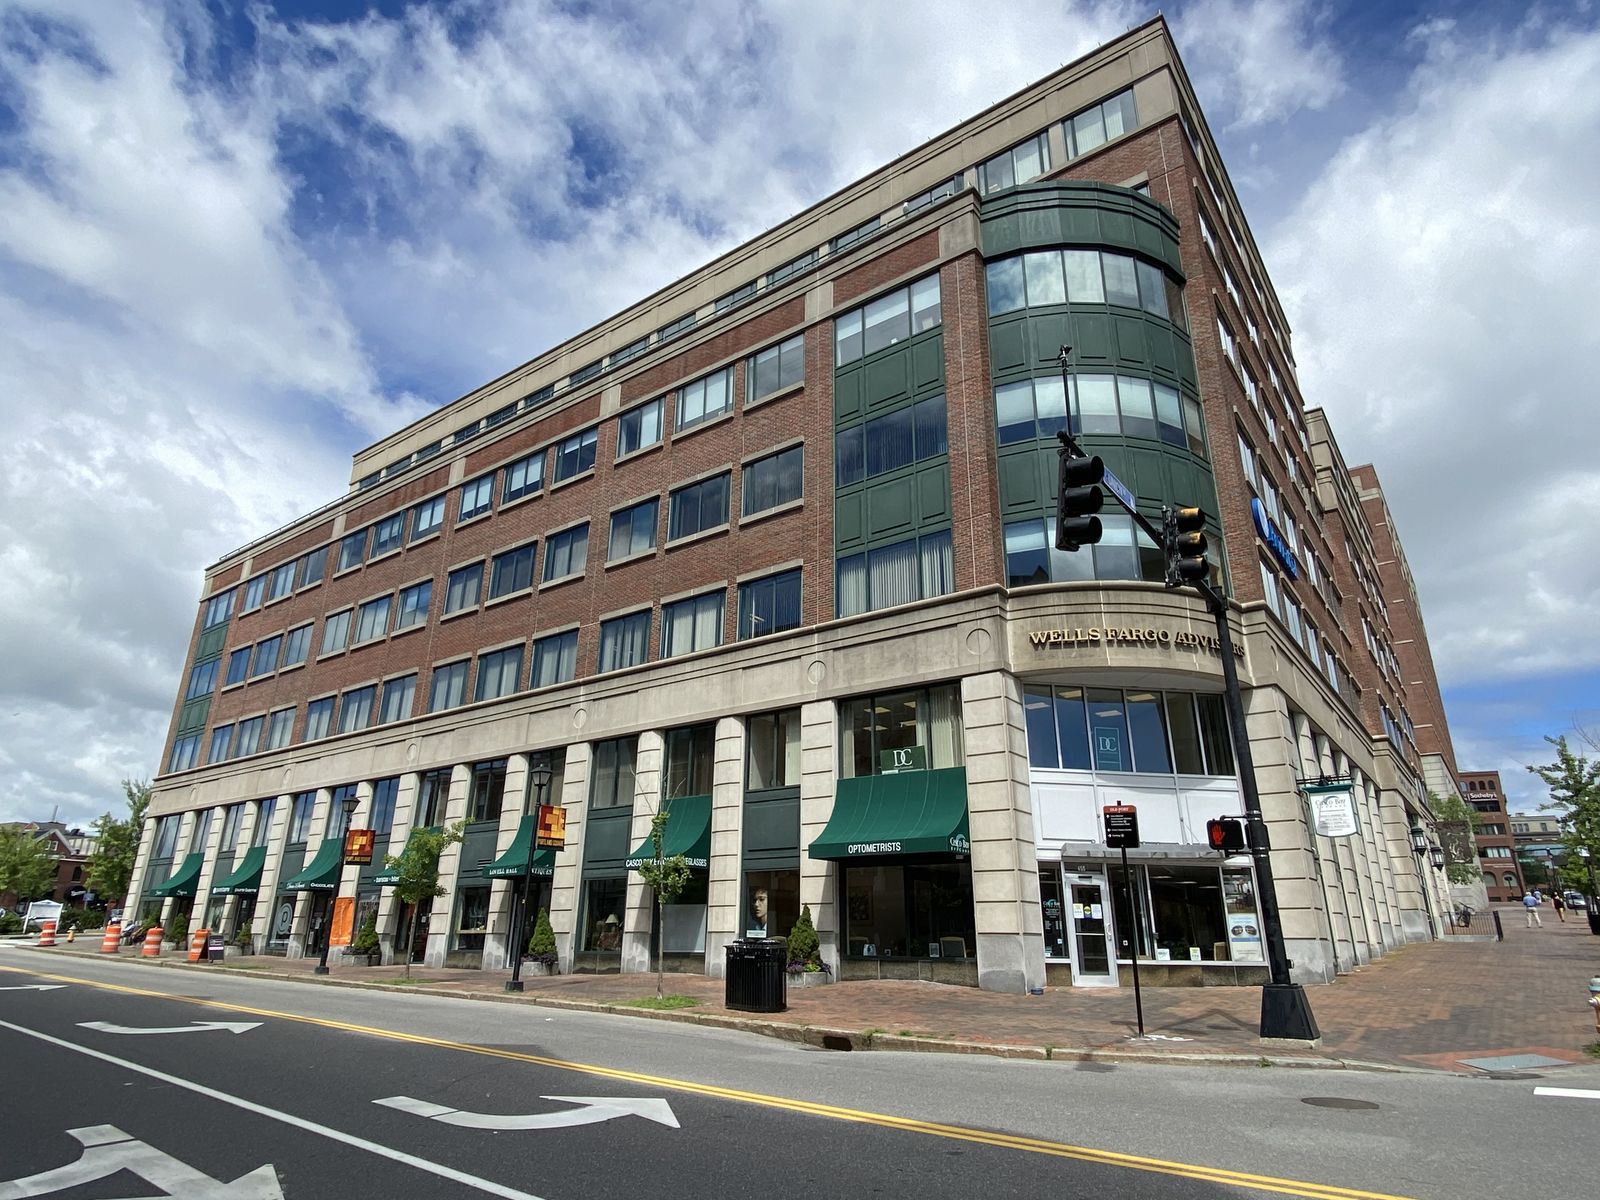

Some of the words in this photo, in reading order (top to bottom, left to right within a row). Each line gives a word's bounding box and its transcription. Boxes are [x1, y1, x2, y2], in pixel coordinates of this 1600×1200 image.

[1029, 627, 1101, 644] WELLS
[1104, 627, 1171, 642] FARGO
[1174, 631, 1246, 657] ADVISRS
[1098, 736, 1117, 752] DC
[893, 748, 913, 767] DC
[847, 842, 902, 854] OPTOMETRISTS
[625, 858, 643, 868] CASCO
